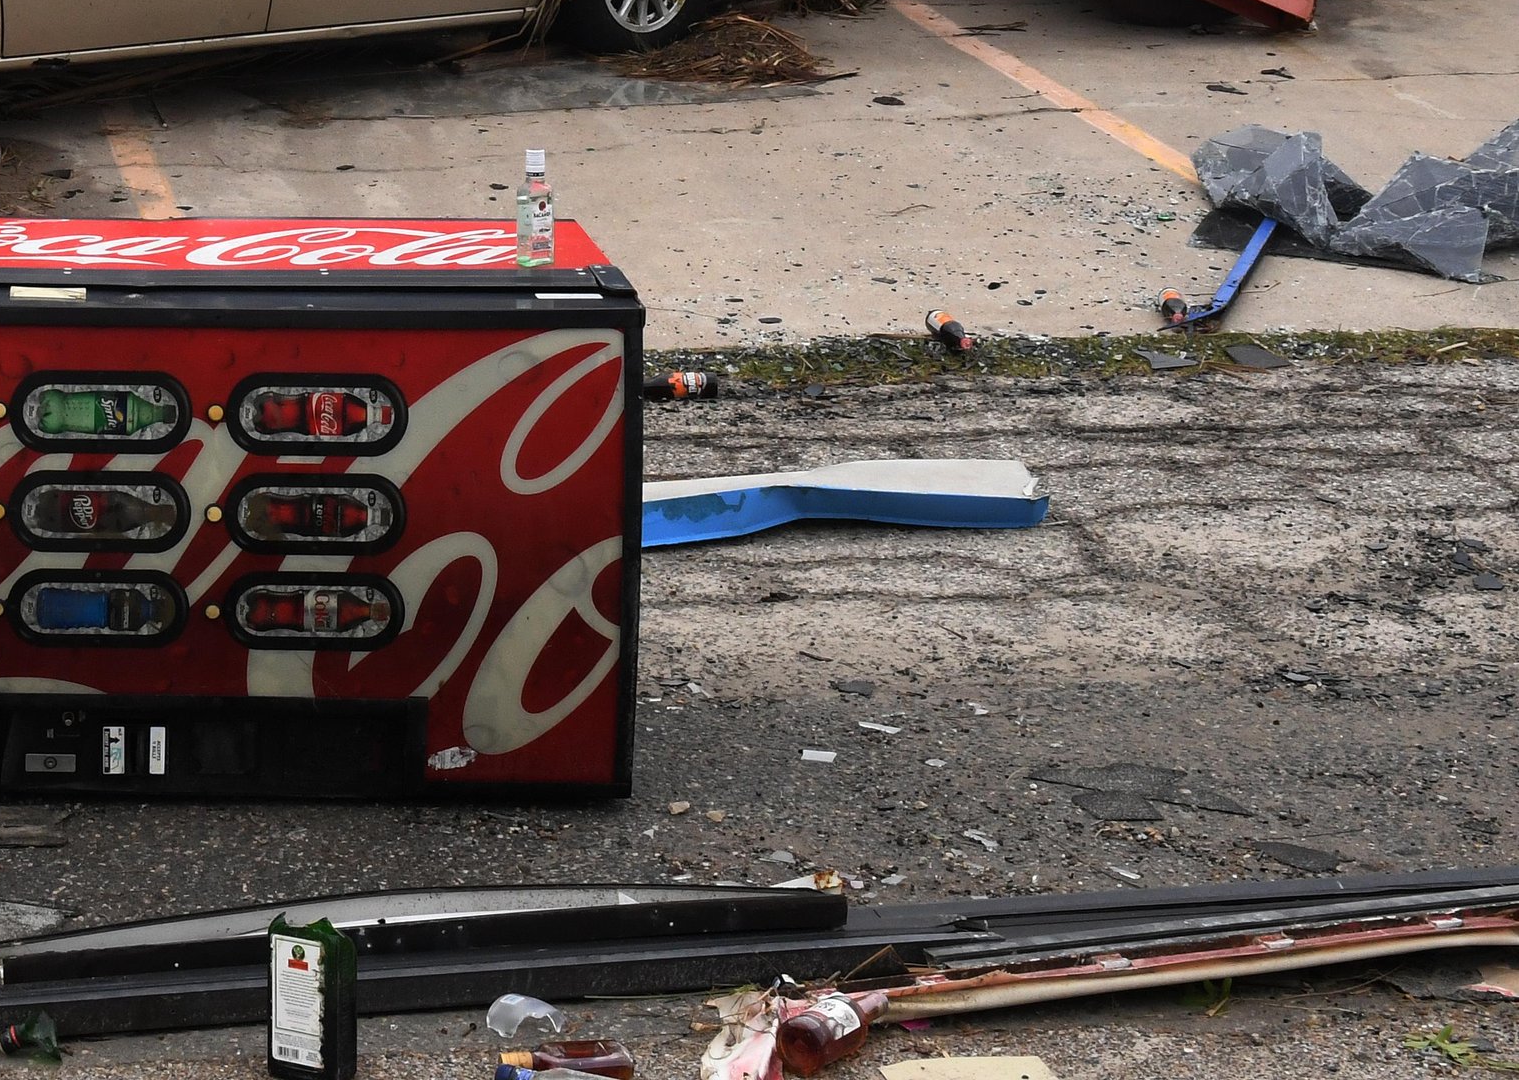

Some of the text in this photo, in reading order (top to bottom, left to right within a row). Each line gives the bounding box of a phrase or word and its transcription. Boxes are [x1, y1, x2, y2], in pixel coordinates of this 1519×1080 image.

[101, 397, 118, 430] Sprite
[320, 393, 338, 435] Coca-Cola
[72, 495, 92, 528] Pepper
[82, 506, 94, 521] Dr
